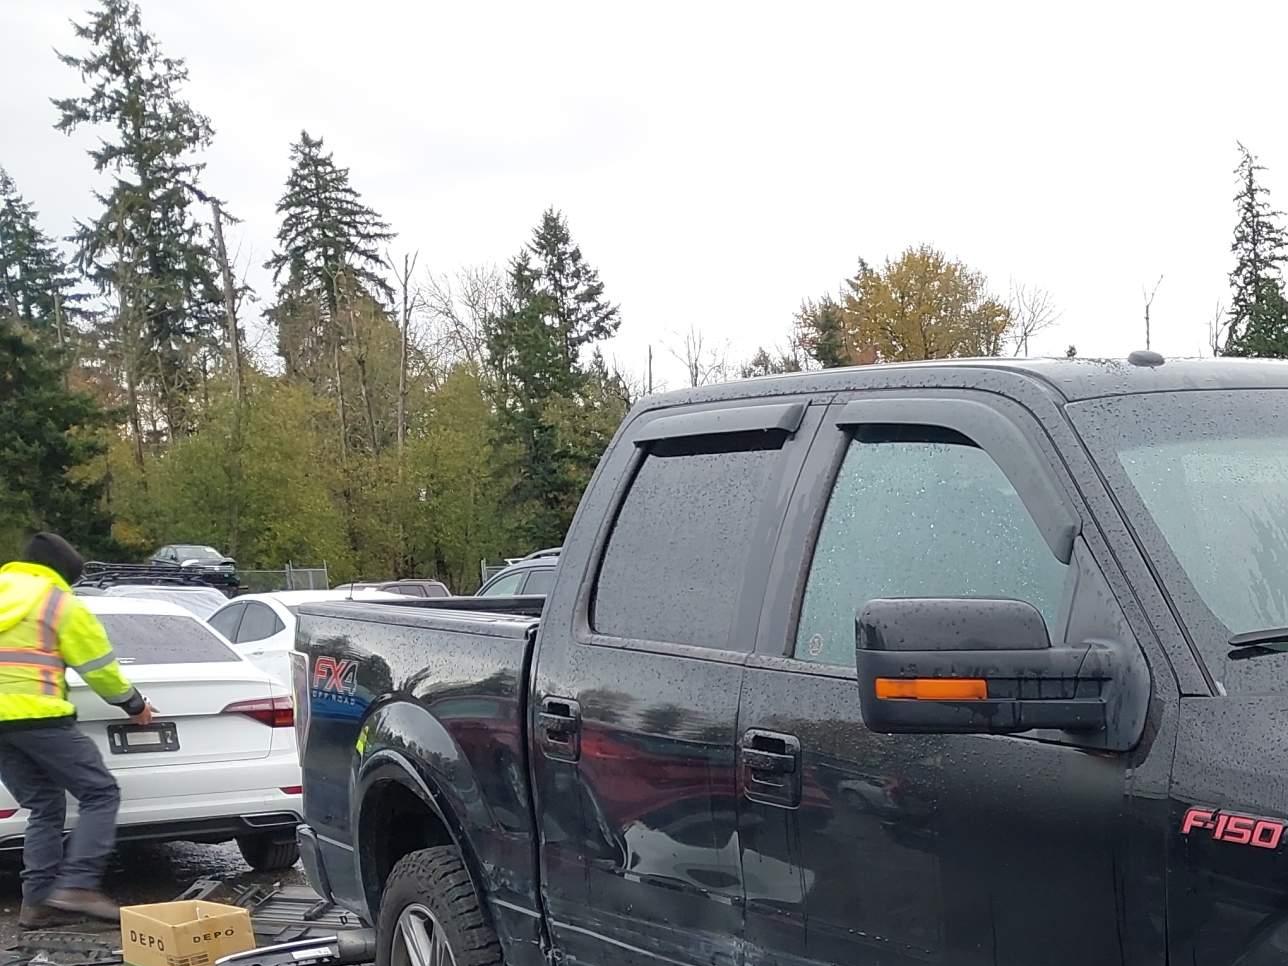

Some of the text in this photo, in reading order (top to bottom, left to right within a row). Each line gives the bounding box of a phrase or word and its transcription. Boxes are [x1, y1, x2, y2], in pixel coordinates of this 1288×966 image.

[313, 655, 359, 696] FX4
[1181, 807, 1286, 850] F-150
[130, 930, 165, 952] DEPO
[193, 929, 235, 944] DEPO
